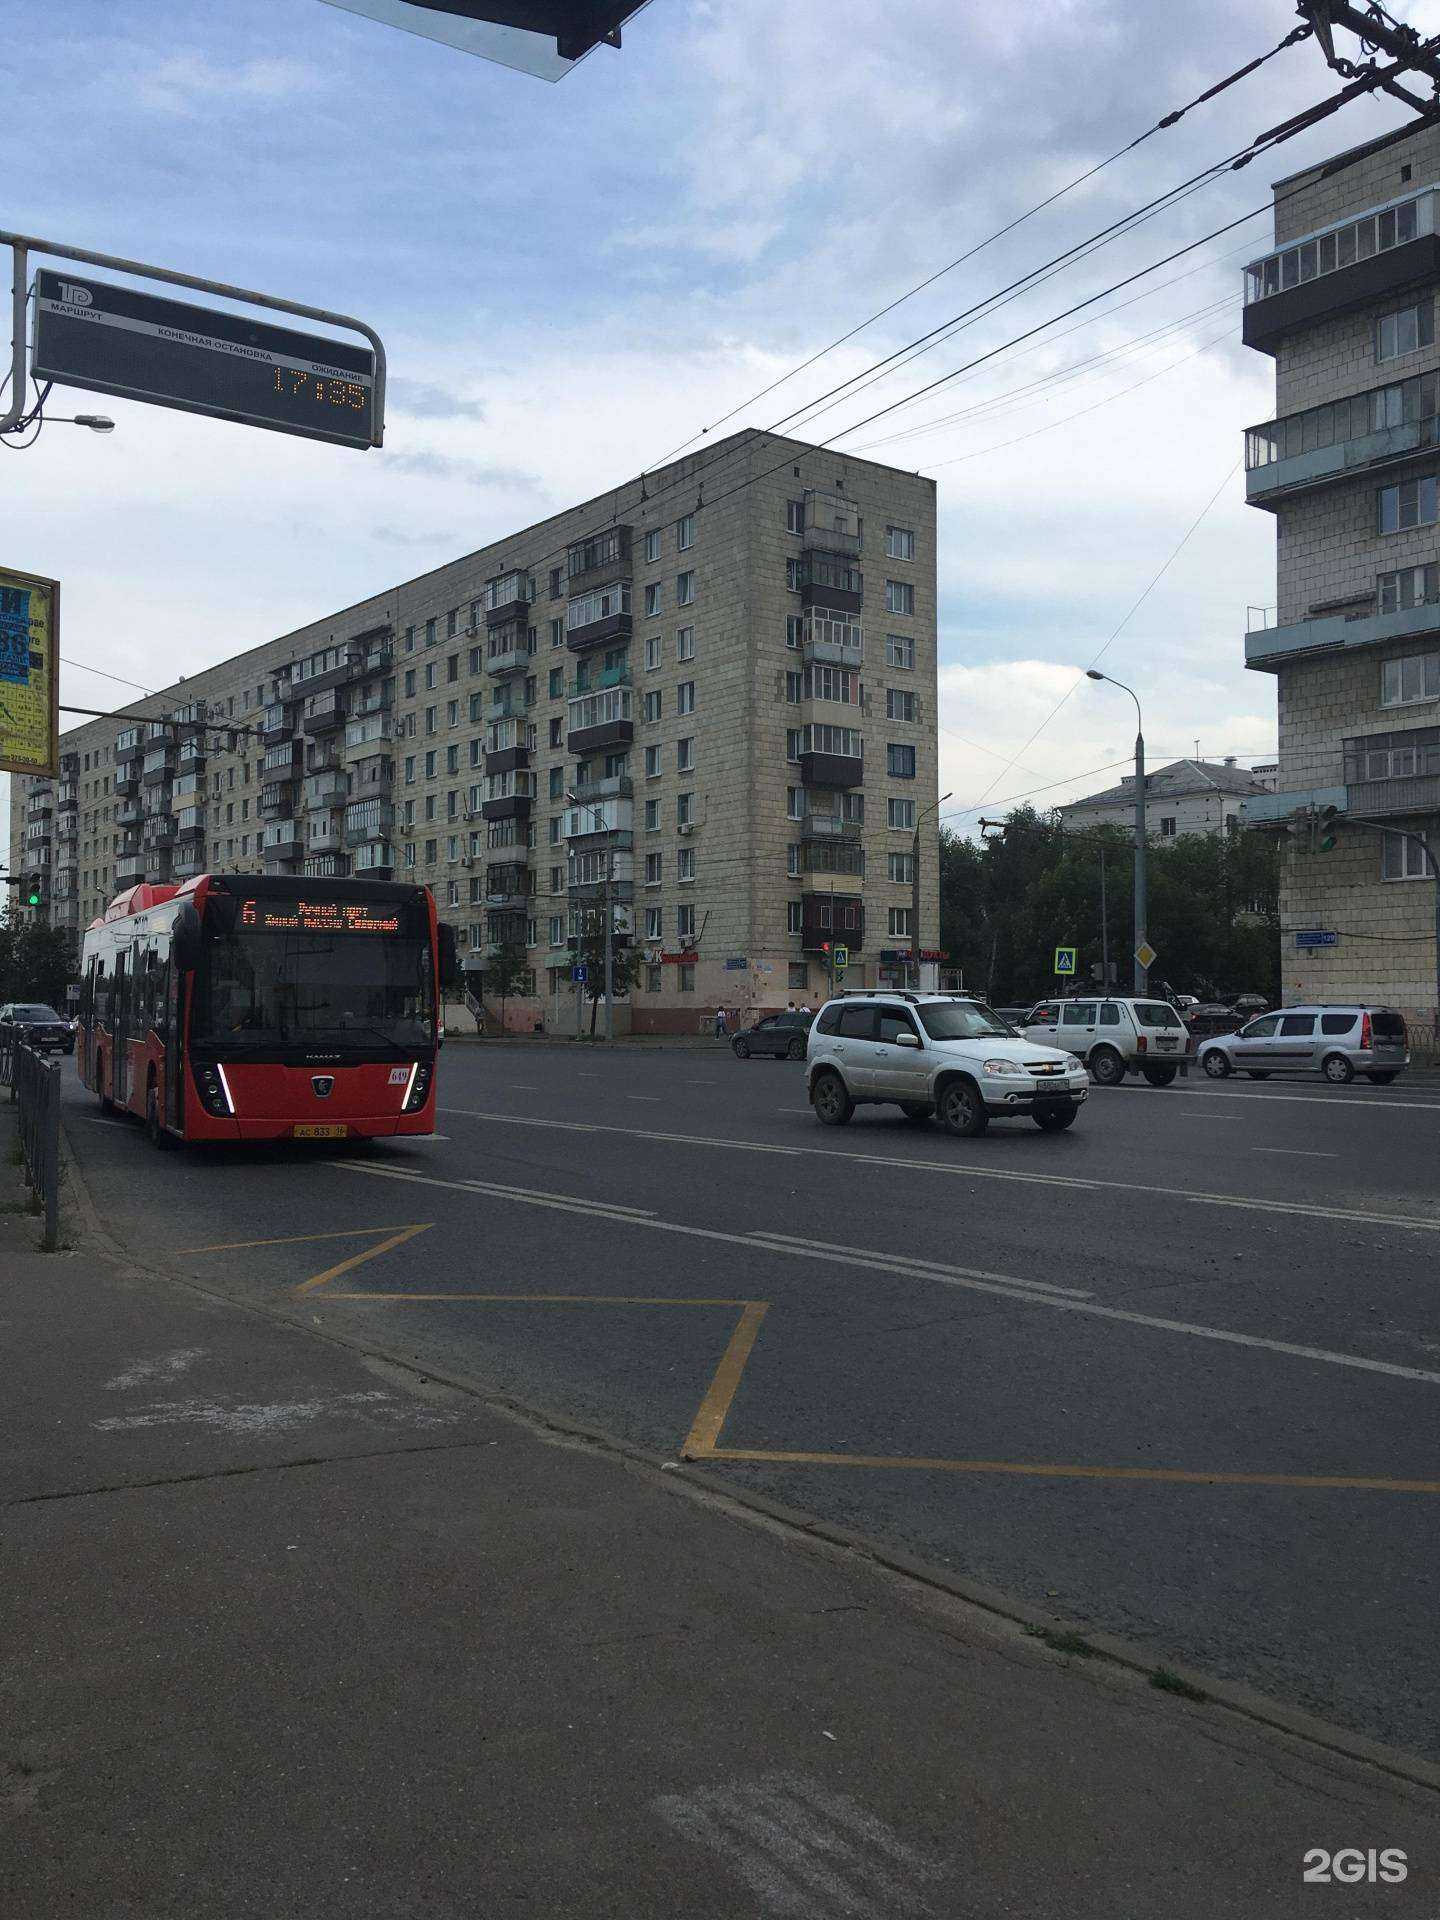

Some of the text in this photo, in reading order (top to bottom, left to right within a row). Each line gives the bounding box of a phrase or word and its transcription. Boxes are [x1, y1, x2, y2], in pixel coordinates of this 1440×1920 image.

[51, 303, 102, 321] МАРШРУТ
[158, 327, 273, 361] КОНЕЧНАЯ ОСТАНОВКА
[311, 364, 363, 382] ОЖИДАНИЕ
[274, 367, 366, 409] 17:35
[242, 900, 256, 924] 6
[313, 1127, 330, 1136] 833
